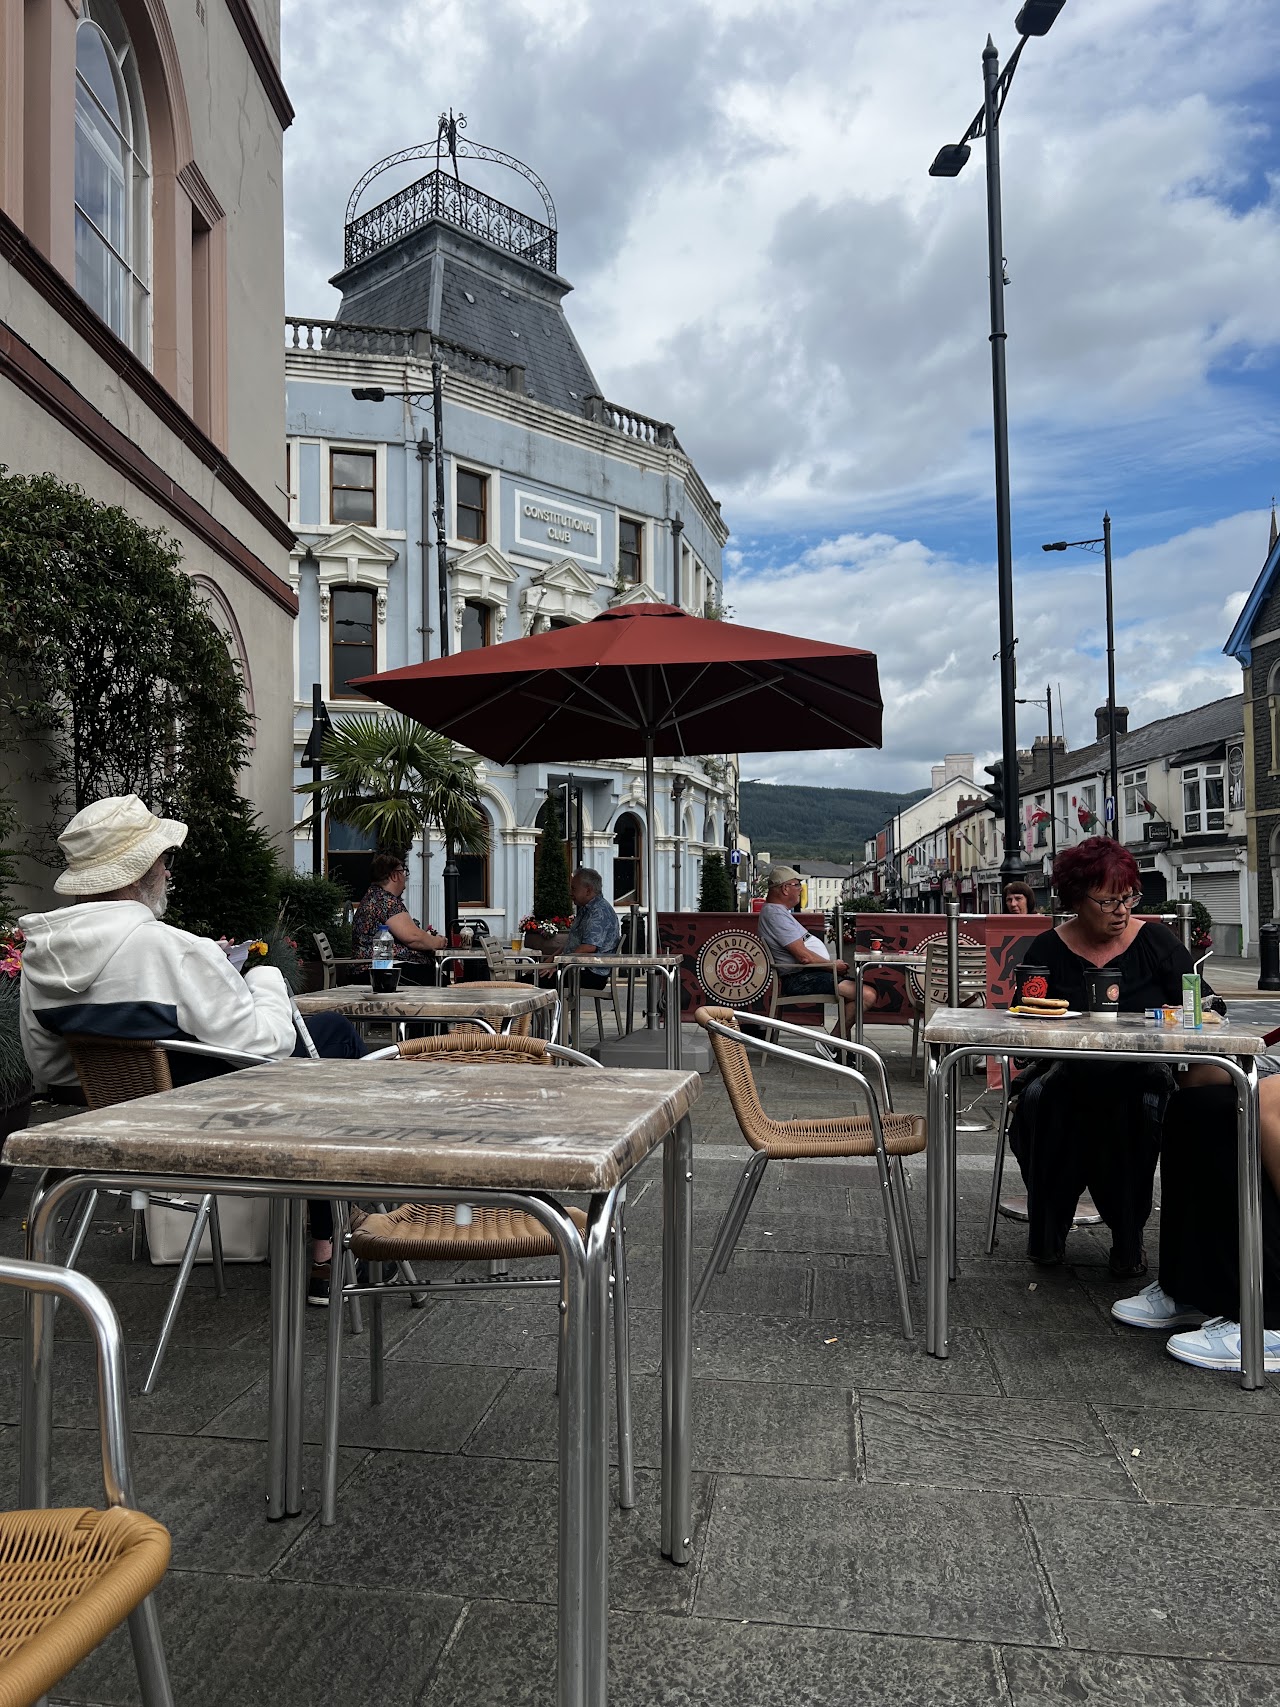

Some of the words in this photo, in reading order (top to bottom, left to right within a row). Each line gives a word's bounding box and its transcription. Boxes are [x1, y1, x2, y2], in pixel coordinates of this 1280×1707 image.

[524, 504, 595, 534] CONSTITUTIONAL
[548, 527, 571, 543] CLUB
[710, 938, 761, 957] BRADLEYS
[712, 982, 758, 997] COFFEE
